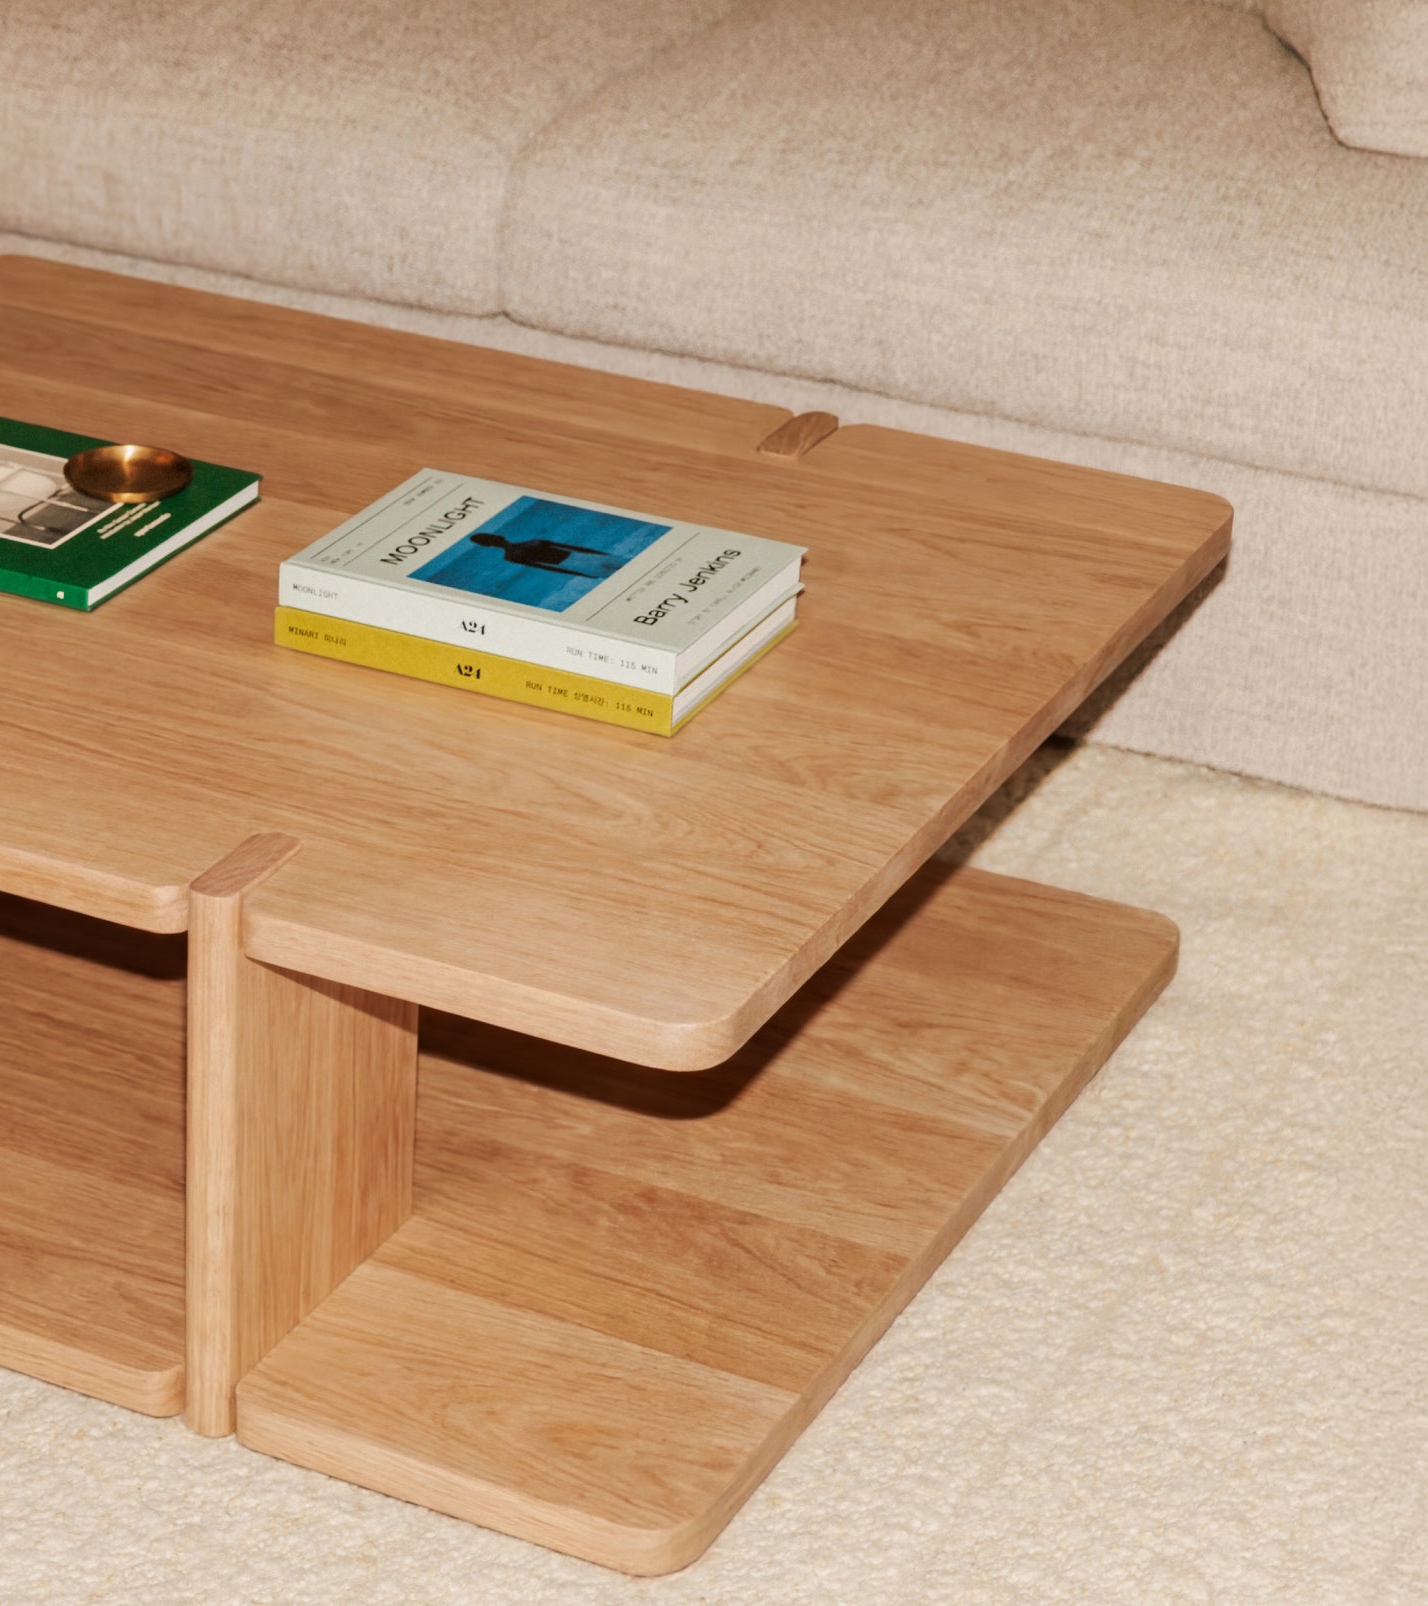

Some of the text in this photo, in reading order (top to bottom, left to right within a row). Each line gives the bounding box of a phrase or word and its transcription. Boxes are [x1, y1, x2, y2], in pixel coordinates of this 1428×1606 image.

[381, 497, 485, 566] MOONLIGHT
[292, 583, 339, 601] MOONLIGHT
[633, 592, 689, 626] Barry
[679, 548, 742, 593] Jenkins
[288, 626, 319, 640] MINARI
[460, 620, 485, 635] A24
[456, 664, 481, 679] A24
[566, 646, 583, 657] RUN
[620, 660, 636, 670] 115
[641, 664, 658, 675] MIN
[525, 681, 542, 692] RUN
[547, 686, 568, 698] TIME
[616, 702, 632, 712] 115
[636, 706, 654, 717] MIN
